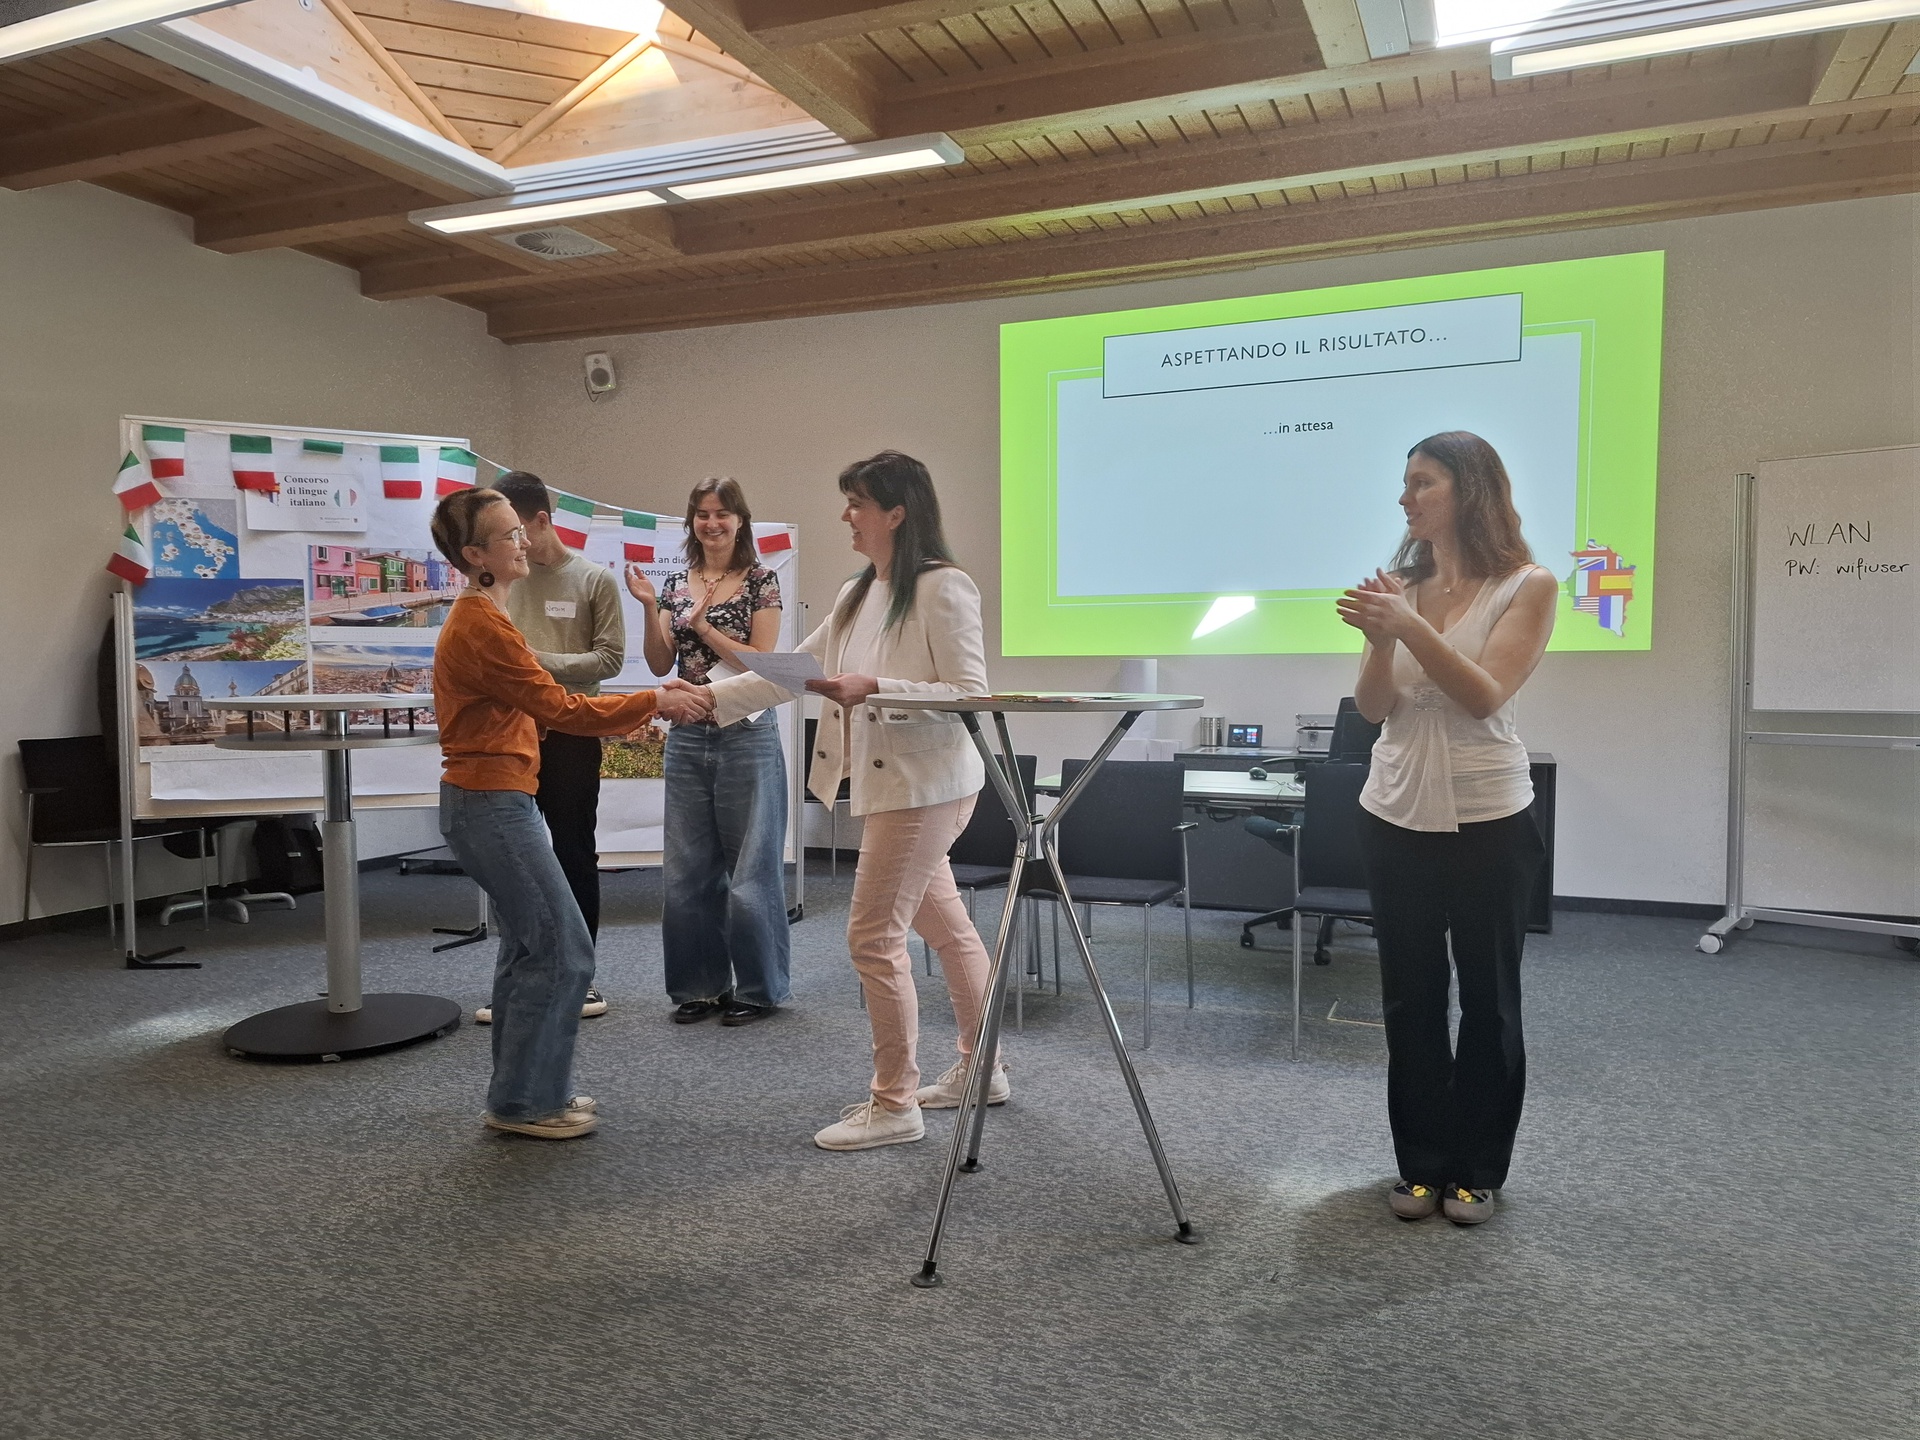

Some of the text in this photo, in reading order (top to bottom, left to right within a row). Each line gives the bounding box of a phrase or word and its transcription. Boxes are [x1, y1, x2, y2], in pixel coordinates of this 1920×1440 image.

[1160, 342, 1288, 368] ASPETTANDO
[1294, 339, 1311, 355] IL
[1294, 420, 1334, 433] attesa
[283, 474, 330, 484] Concorso
[286, 486, 328, 497] di lingue
[290, 498, 326, 507] italiano
[1786, 520, 1871, 547] WLAN
[658, 556, 670, 564] an
[672, 555, 686, 564] die
[1784, 557, 1910, 580] PW: wifiuser
